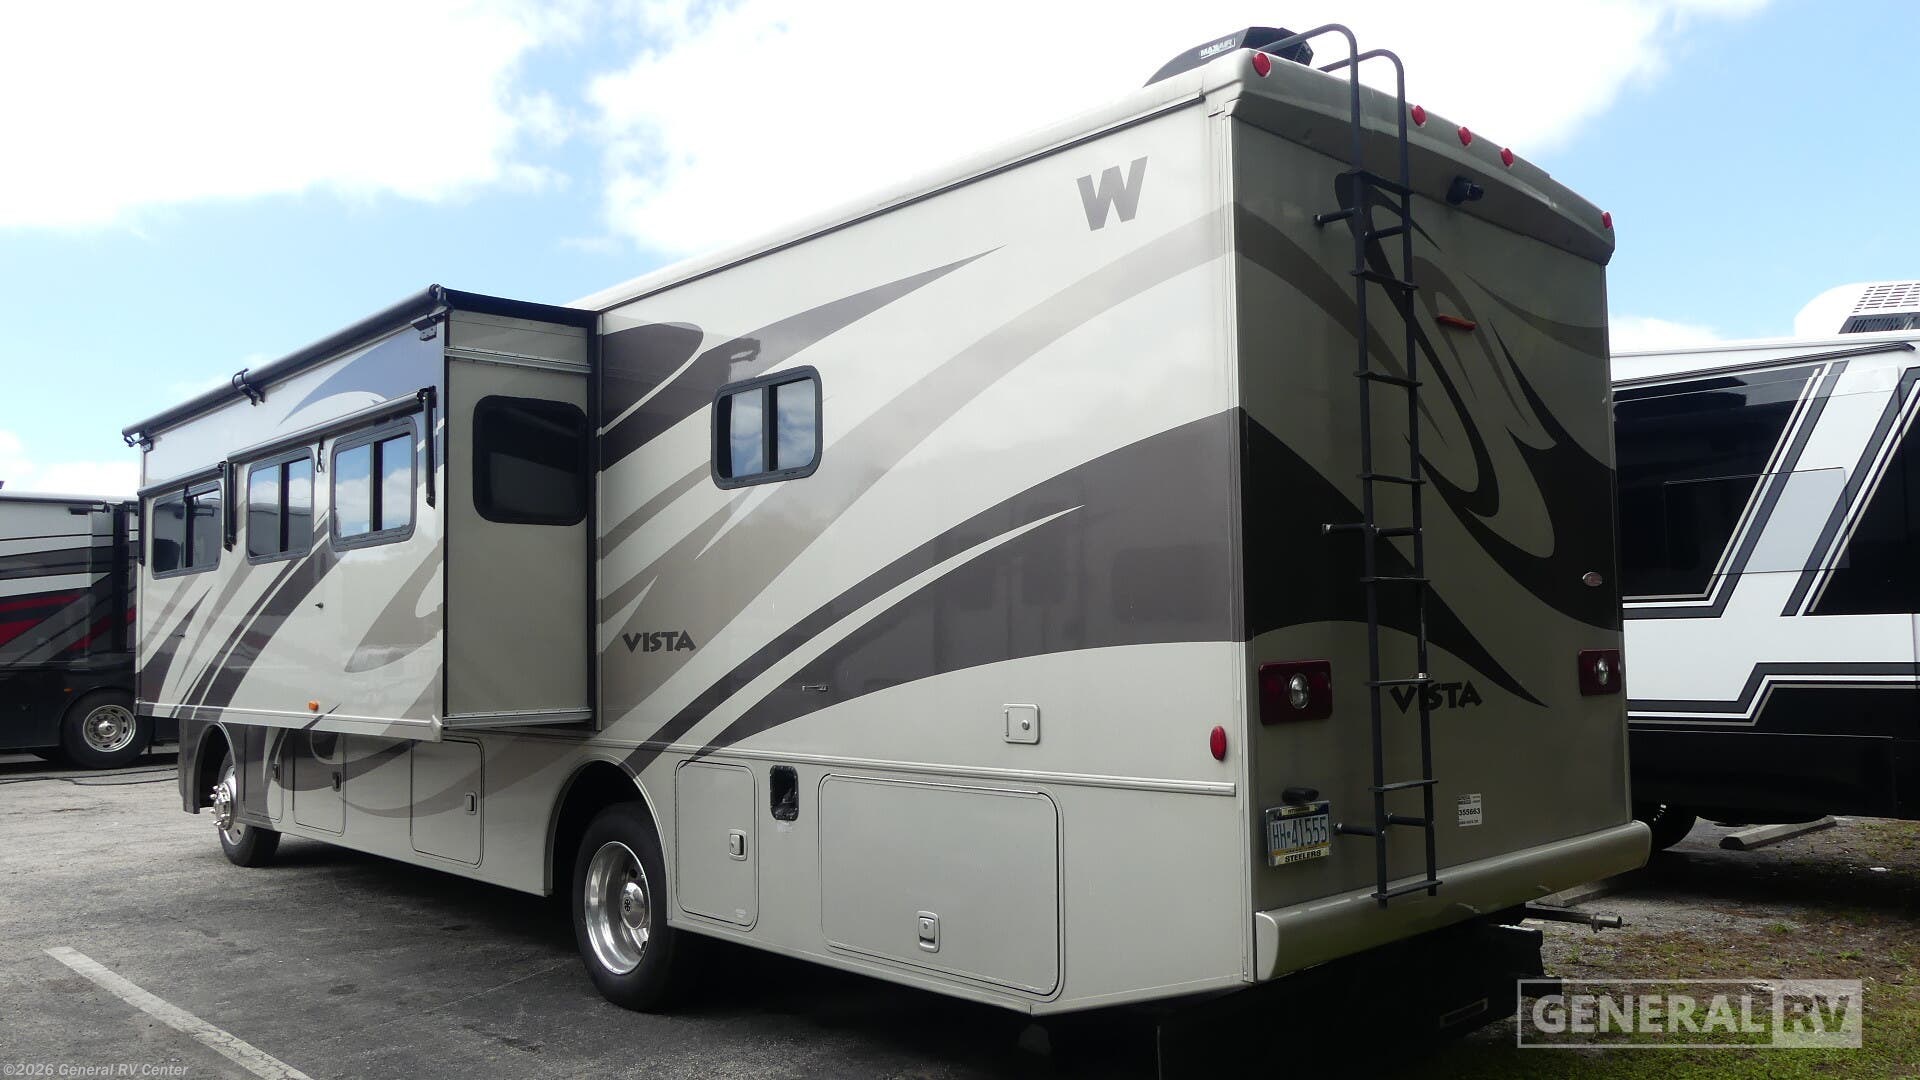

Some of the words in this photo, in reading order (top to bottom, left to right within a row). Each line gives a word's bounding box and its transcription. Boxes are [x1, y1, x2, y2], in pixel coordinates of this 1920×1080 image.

[1076, 156, 1148, 231] W
[622, 630, 696, 653] VISTA
[1284, 849, 1322, 863] STEELERS
